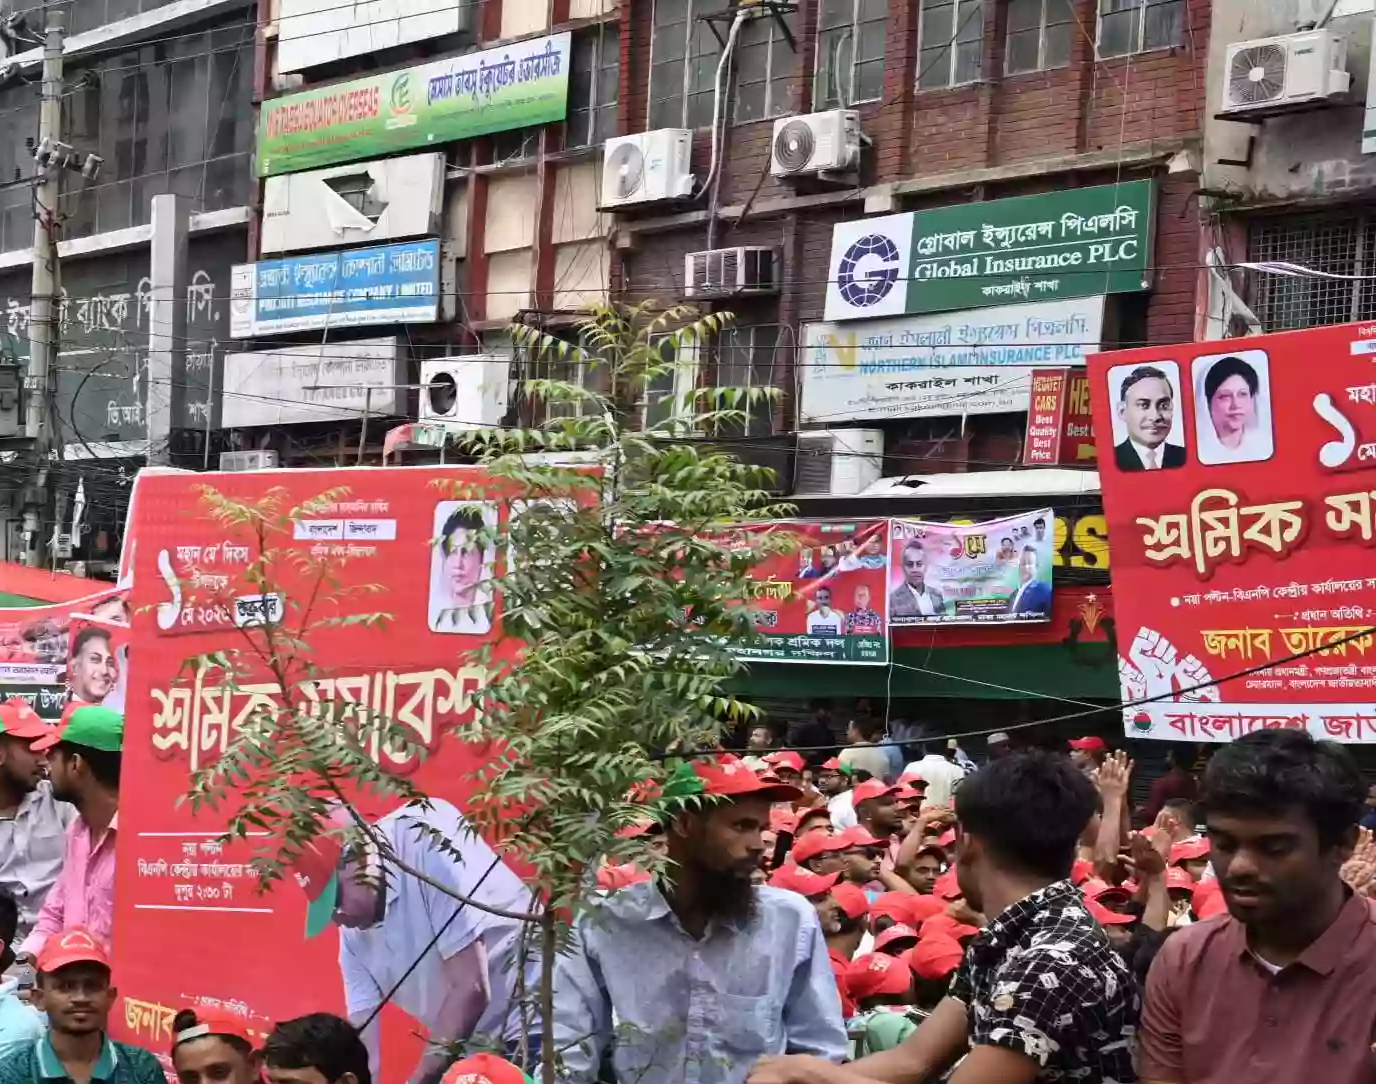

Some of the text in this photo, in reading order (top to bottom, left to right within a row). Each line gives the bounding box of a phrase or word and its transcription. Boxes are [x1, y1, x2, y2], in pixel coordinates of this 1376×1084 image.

[1061, 205, 1138, 238] পিএলসি
[914, 240, 1139, 282] Global Insurance PLC
[1034, 278, 1060, 294] শাখা
[858, 356, 926, 376] NORTHERN
[885, 374, 1000, 393] কাকরাইল শাখা
[1034, 395, 1057, 412] CARS
[1312, 392, 1356, 468] ১
[1135, 488, 1304, 574] শ্রমিক
[221, 539, 250, 564] দিবস
[1183, 593, 1202, 609] নয়া
[1272, 578, 1308, 600] কেন্দ্রীয়
[1311, 573, 1363, 594] কার্যালয়ের
[1330, 606, 1364, 620] অতিথি
[825, 638, 846, 650] দল
[1200, 624, 1376, 661] জনাব তারেক
[150, 658, 281, 773] শ্রমিক
[137, 858, 169, 878] বিএনপি
[174, 884, 194, 902] দুপুর
[124, 996, 178, 1042] জনাব
